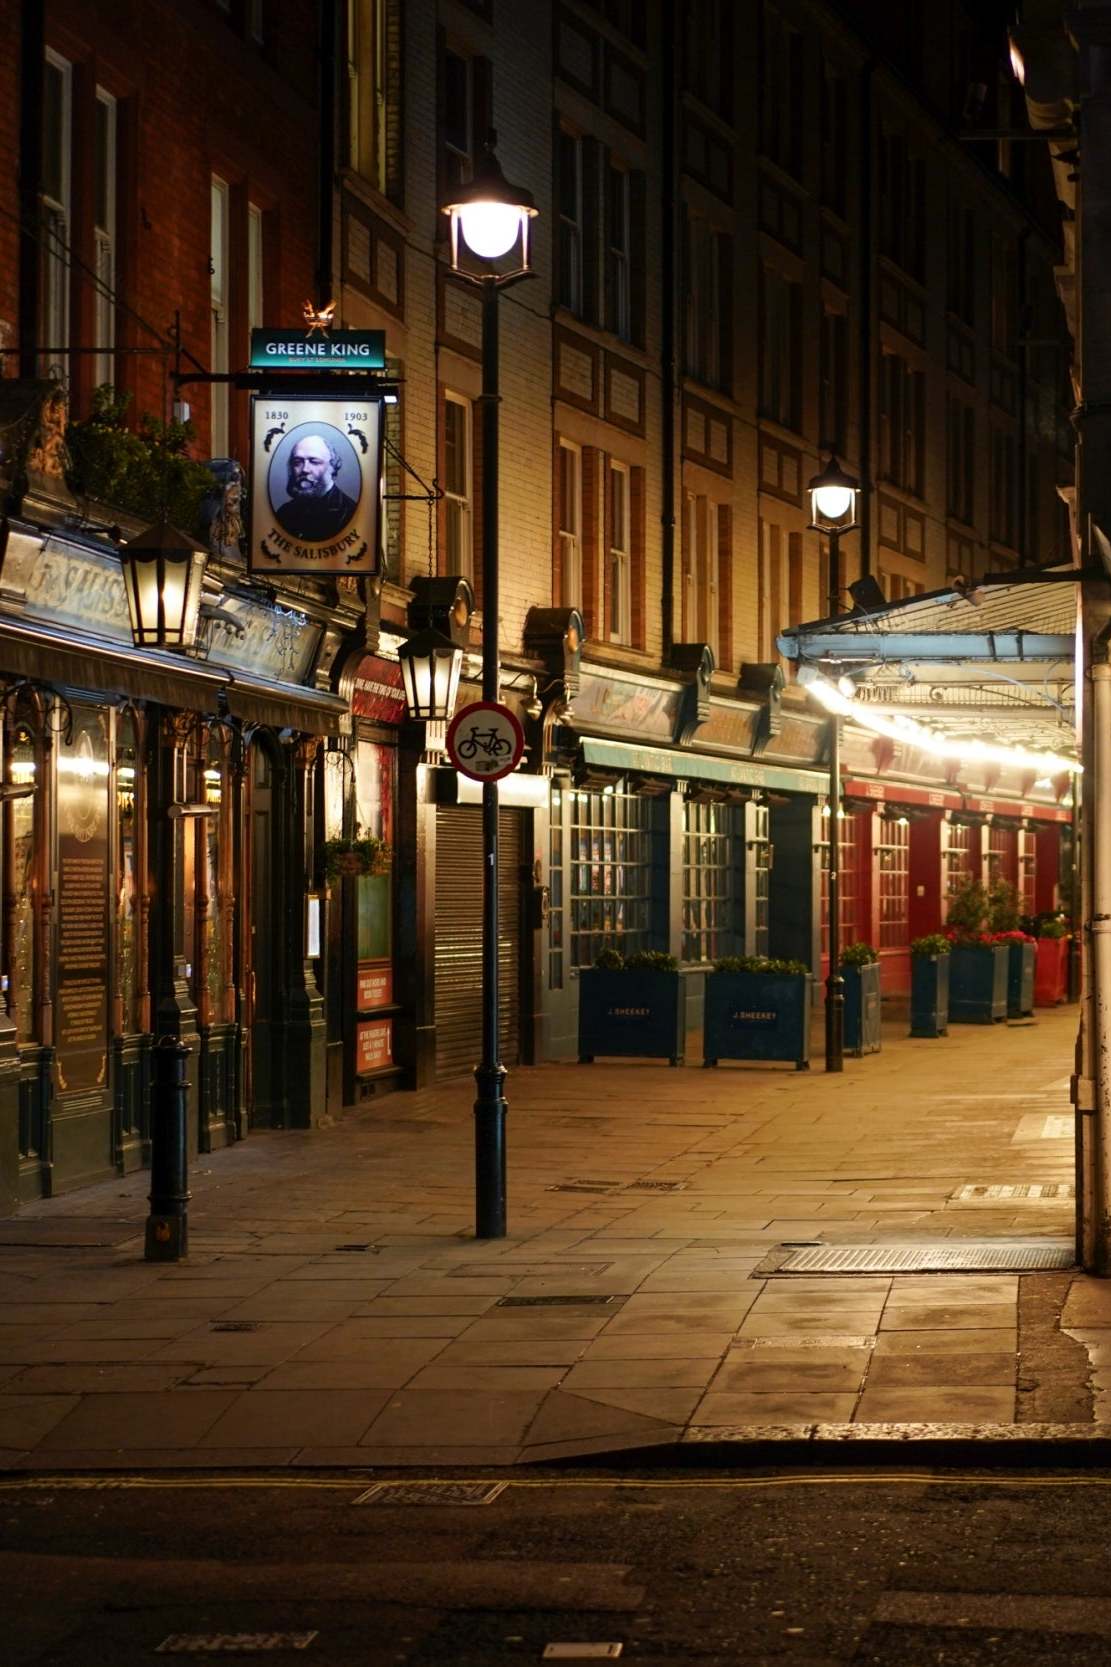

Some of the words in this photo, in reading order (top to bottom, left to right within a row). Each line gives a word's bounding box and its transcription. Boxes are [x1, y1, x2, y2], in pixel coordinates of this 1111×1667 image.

[265, 343, 326, 355] GREENE
[331, 344, 370, 356] KING
[265, 411, 289, 420] 1830
[344, 412, 368, 421] 1903
[267, 528, 290, 554] THE
[295, 528, 361, 560] SALISBURY
